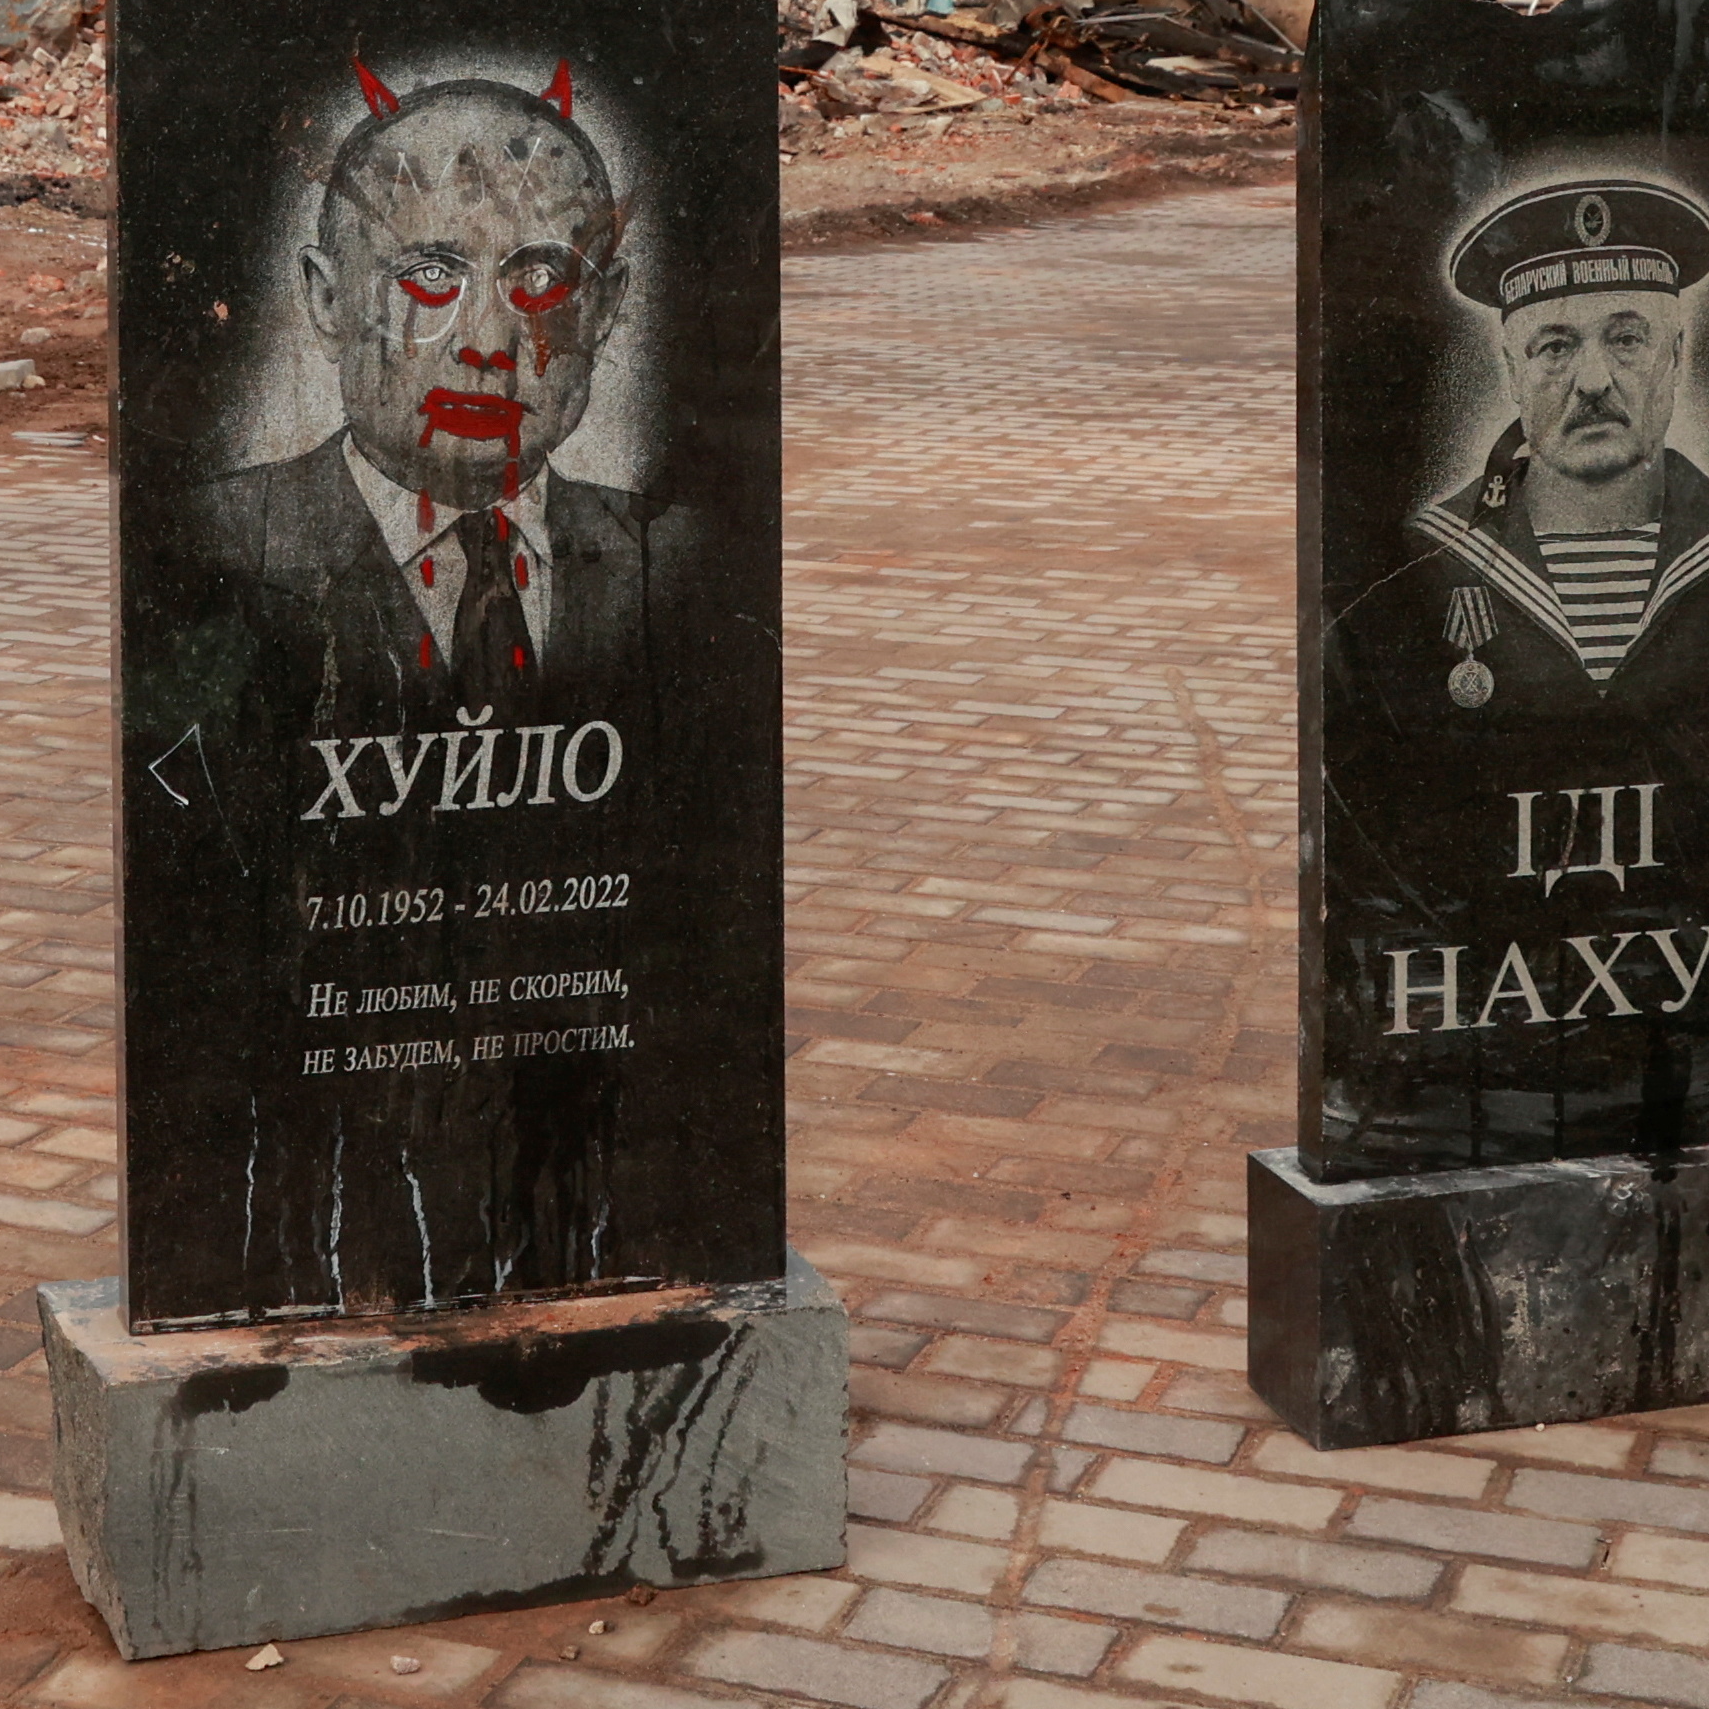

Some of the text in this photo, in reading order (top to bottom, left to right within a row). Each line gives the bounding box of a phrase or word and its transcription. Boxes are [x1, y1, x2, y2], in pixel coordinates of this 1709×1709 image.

[1571, 254, 1631, 285] ВОЕННЫЙ
[300, 704, 624, 821] ХУЙЛО
[1506, 782, 1666, 898] ІДІ
[305, 887, 445, 931] 7.10.1952
[473, 872, 631, 919] 24.02.2022
[355, 982, 458, 1015] ЛЮБИМ,
[467, 978, 502, 1006] НЕ
[508, 968, 630, 1002] СКОРБИМ,
[301, 1023, 637, 1076] НЕ ЗАБУДЕМ, НЕ ПРОСТИМ.
